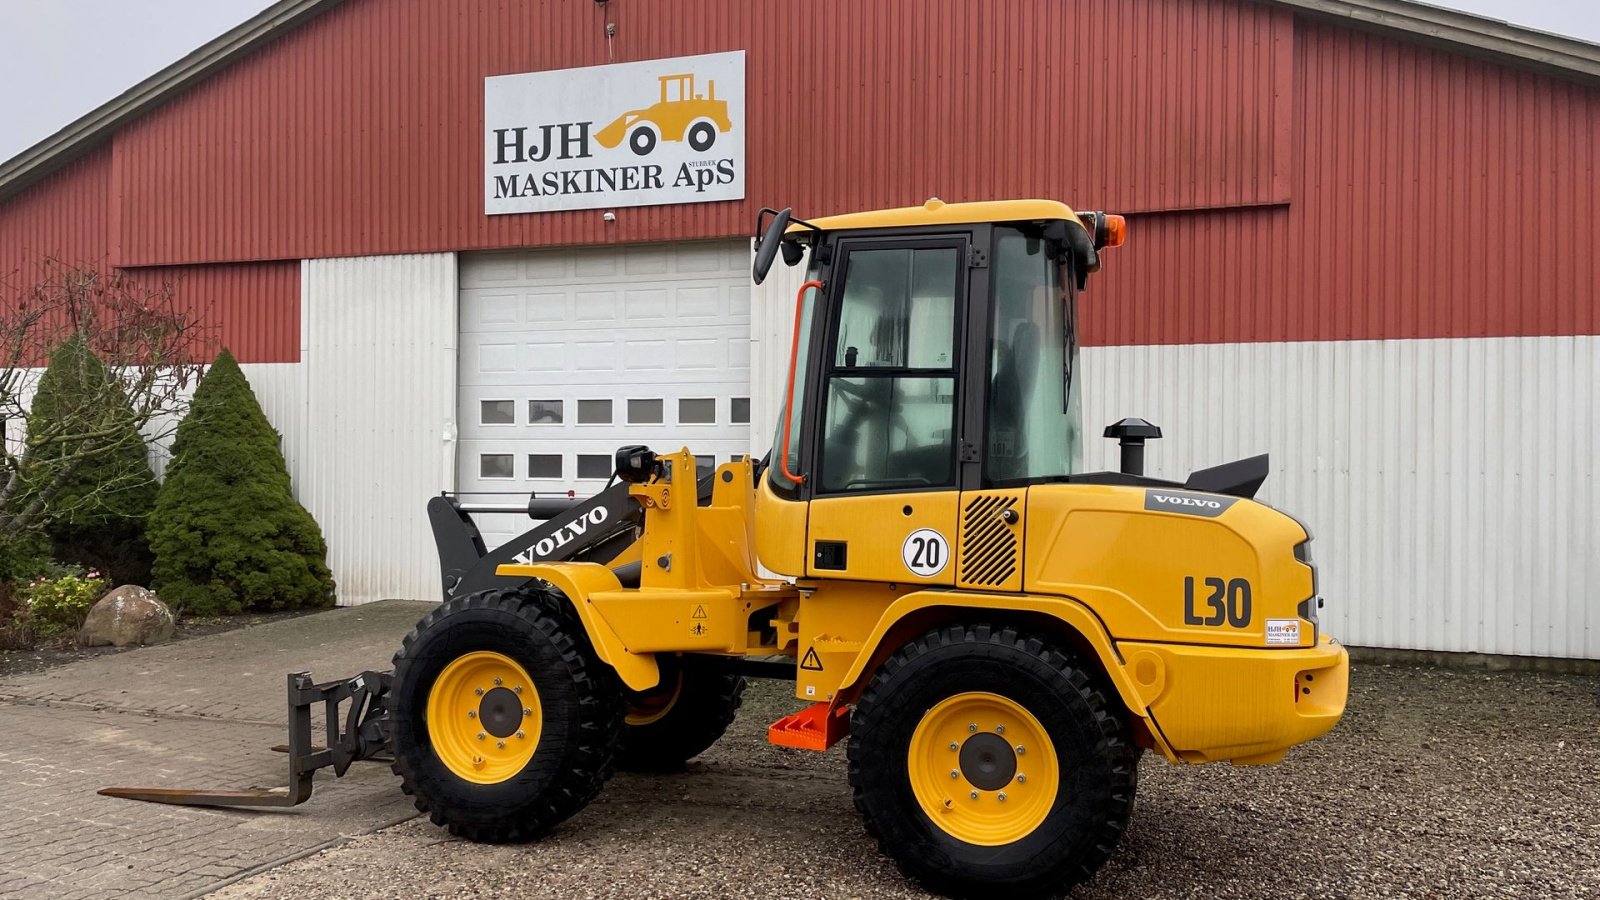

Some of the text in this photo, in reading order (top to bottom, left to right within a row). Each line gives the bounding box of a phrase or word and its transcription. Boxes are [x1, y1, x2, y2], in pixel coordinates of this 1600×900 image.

[493, 121, 593, 164] HJH
[493, 158, 735, 199] MASKINER ApS
[1153, 495, 1221, 509] VOLVO
[512, 505, 609, 565] VOLVO
[911, 537, 940, 568] 20
[1184, 576, 1252, 628] L30
